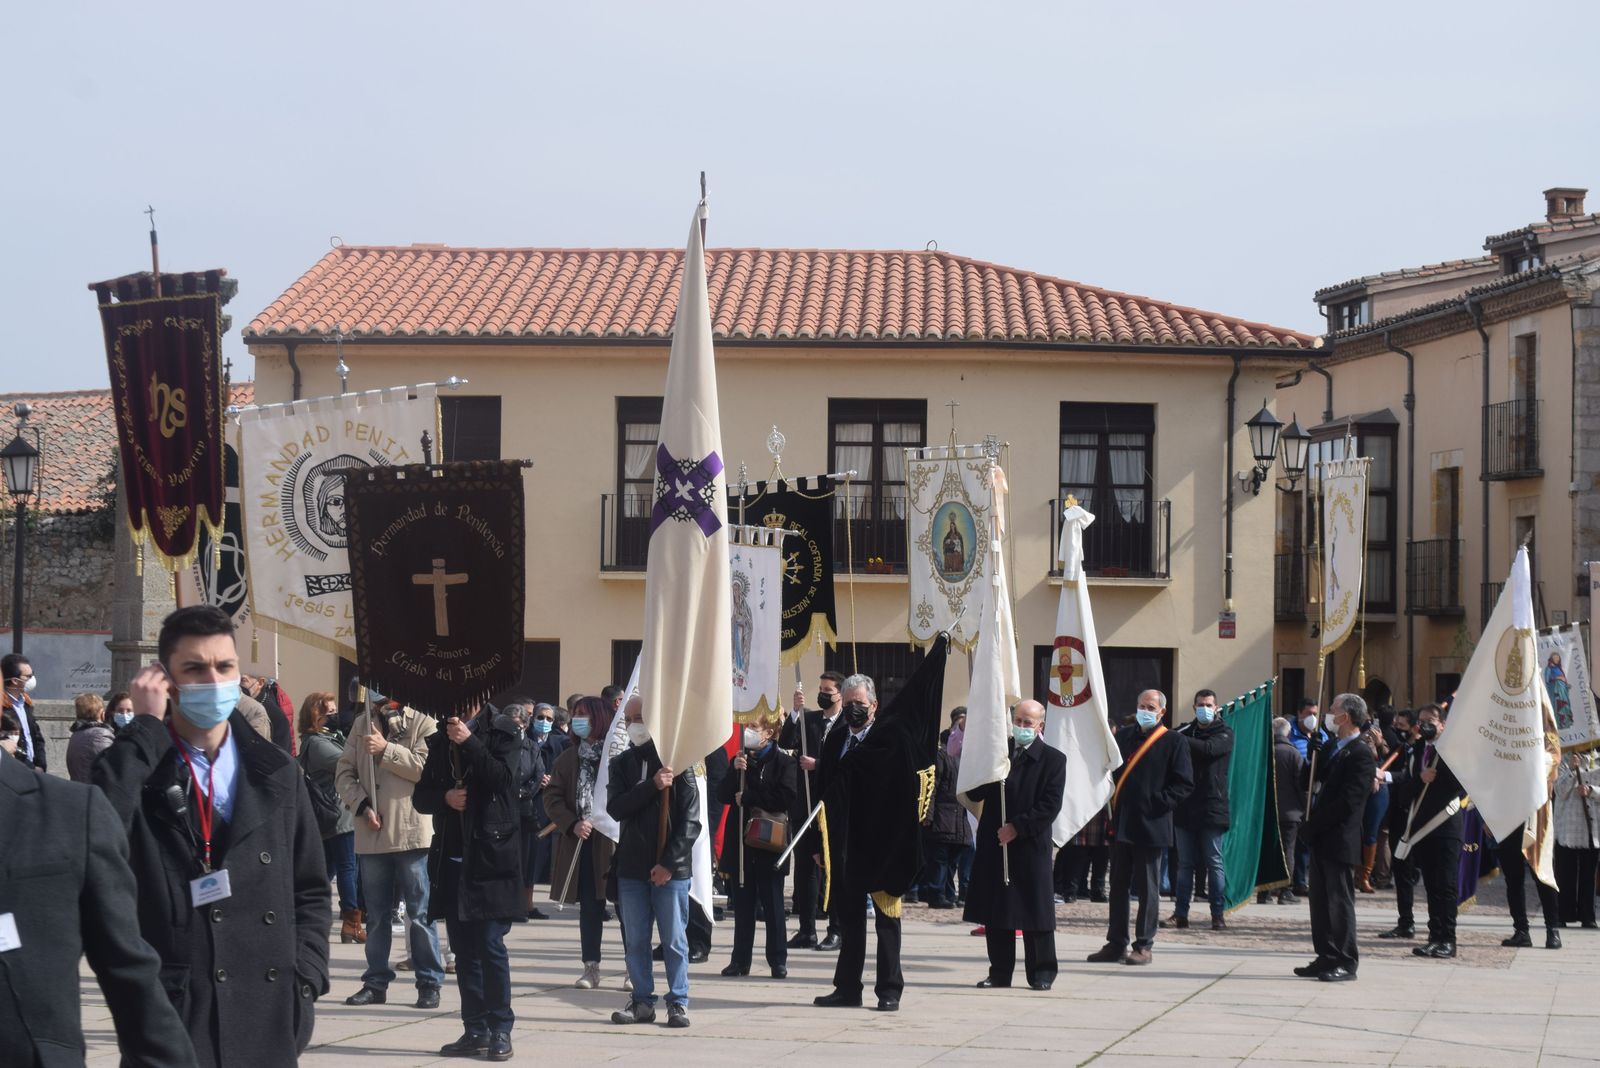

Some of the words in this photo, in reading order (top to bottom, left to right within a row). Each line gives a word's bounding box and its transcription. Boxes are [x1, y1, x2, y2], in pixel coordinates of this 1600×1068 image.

[260, 425, 330, 562] HERMANDAD
[345, 420, 417, 464] PENIT
[433, 501, 448, 517] de
[789, 521, 809, 541] REAL
[807, 586, 817, 598] DE
[343, 603, 354, 619] L
[782, 596, 810, 619] NUESTR
[335, 625, 354, 637] ZA
[1490, 692, 1536, 709] HERMANDAD
[1503, 713, 1517, 723] DEL
[1478, 726, 1507, 747] CORPUS
[1493, 748, 1522, 760] ZAMORA
